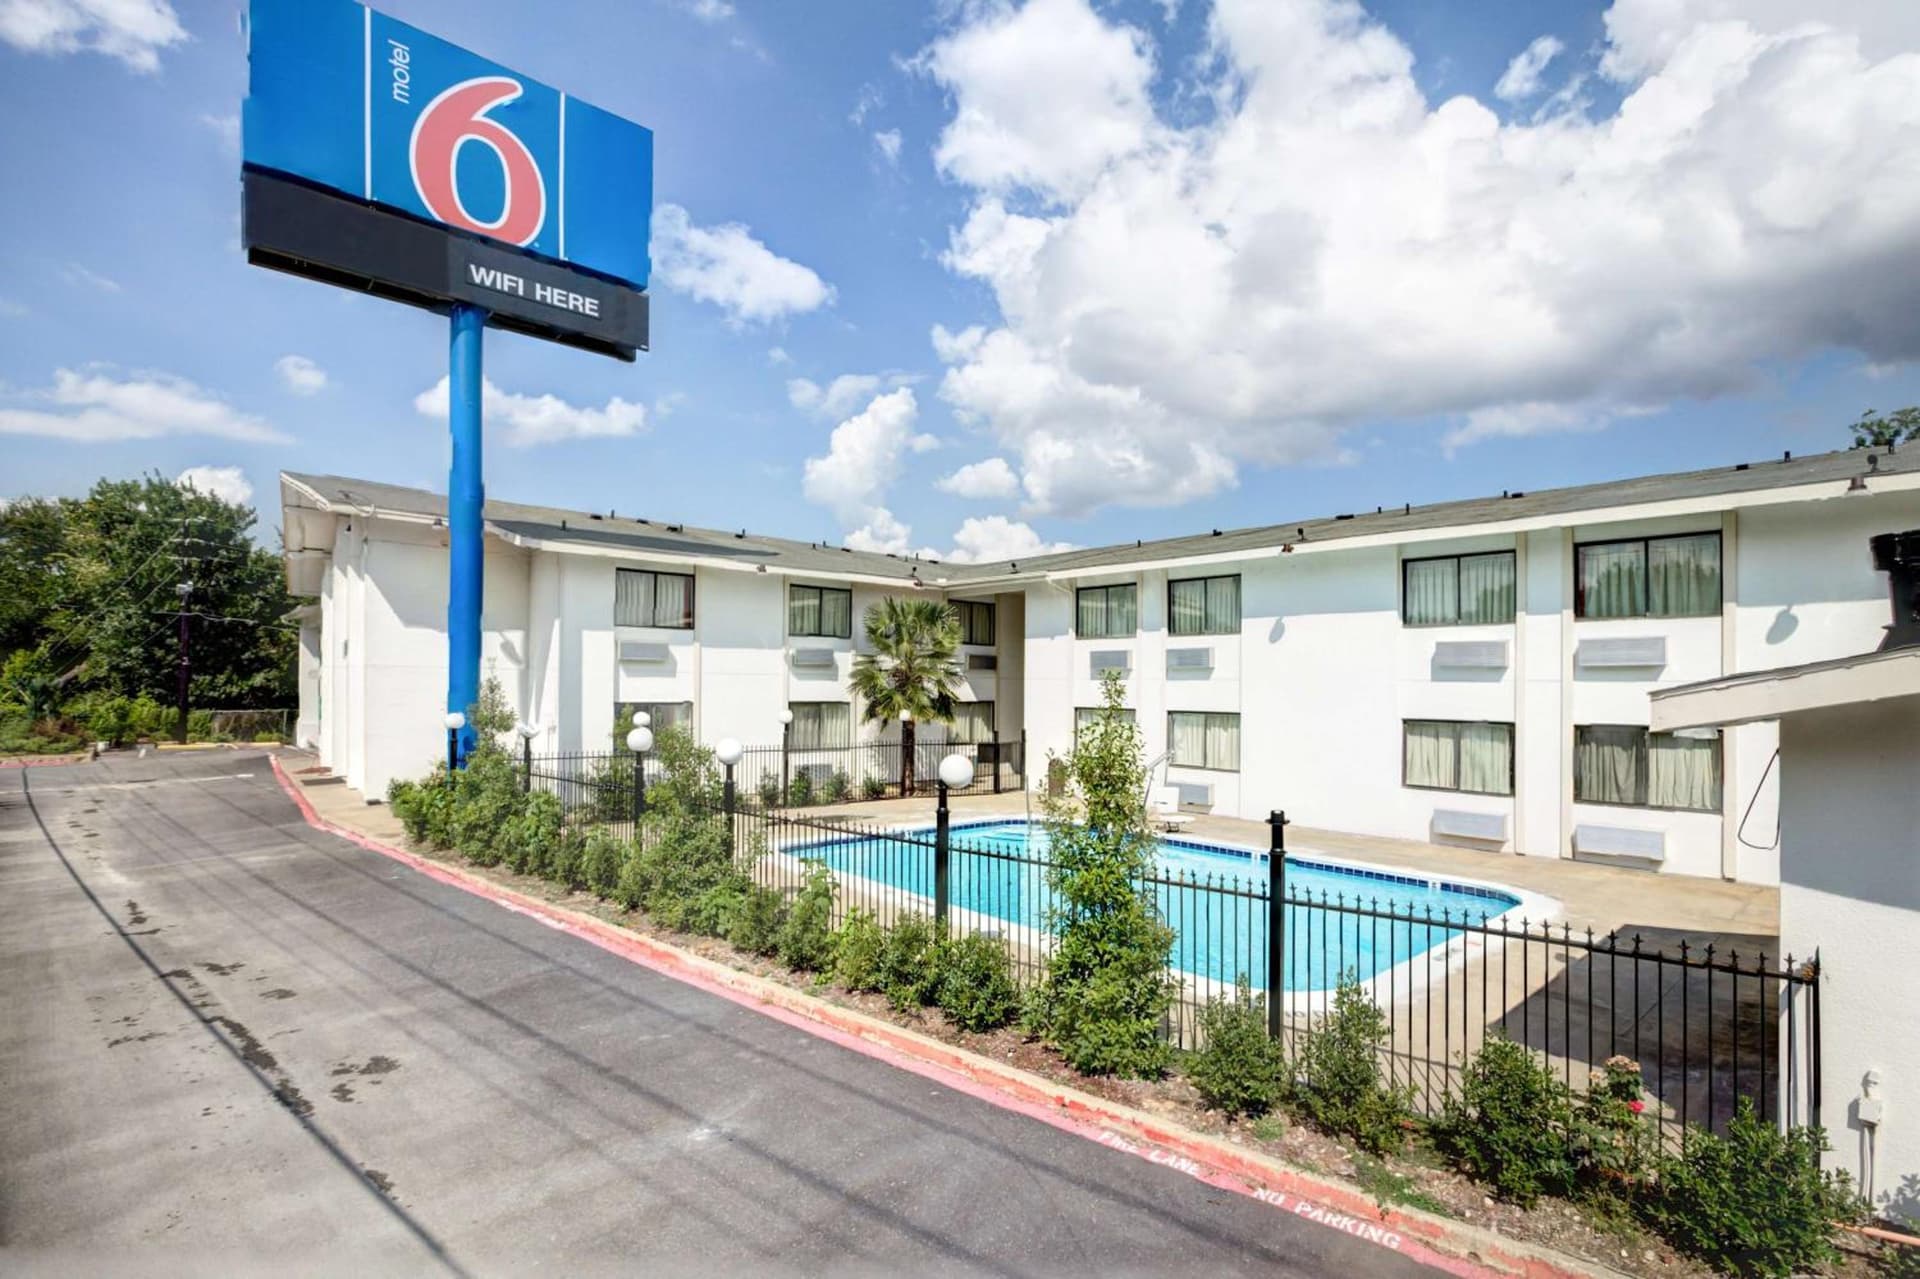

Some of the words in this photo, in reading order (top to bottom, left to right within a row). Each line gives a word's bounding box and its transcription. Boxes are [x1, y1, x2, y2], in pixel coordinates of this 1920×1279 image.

[388, 39, 410, 105] motel
[409, 76, 547, 248] 6
[469, 263, 524, 297] WIFI
[535, 282, 600, 318] HERE
[1149, 1149, 1200, 1176] LANE
[1253, 1187, 1287, 1206] NO
[1294, 1201, 1401, 1250] PARKING
